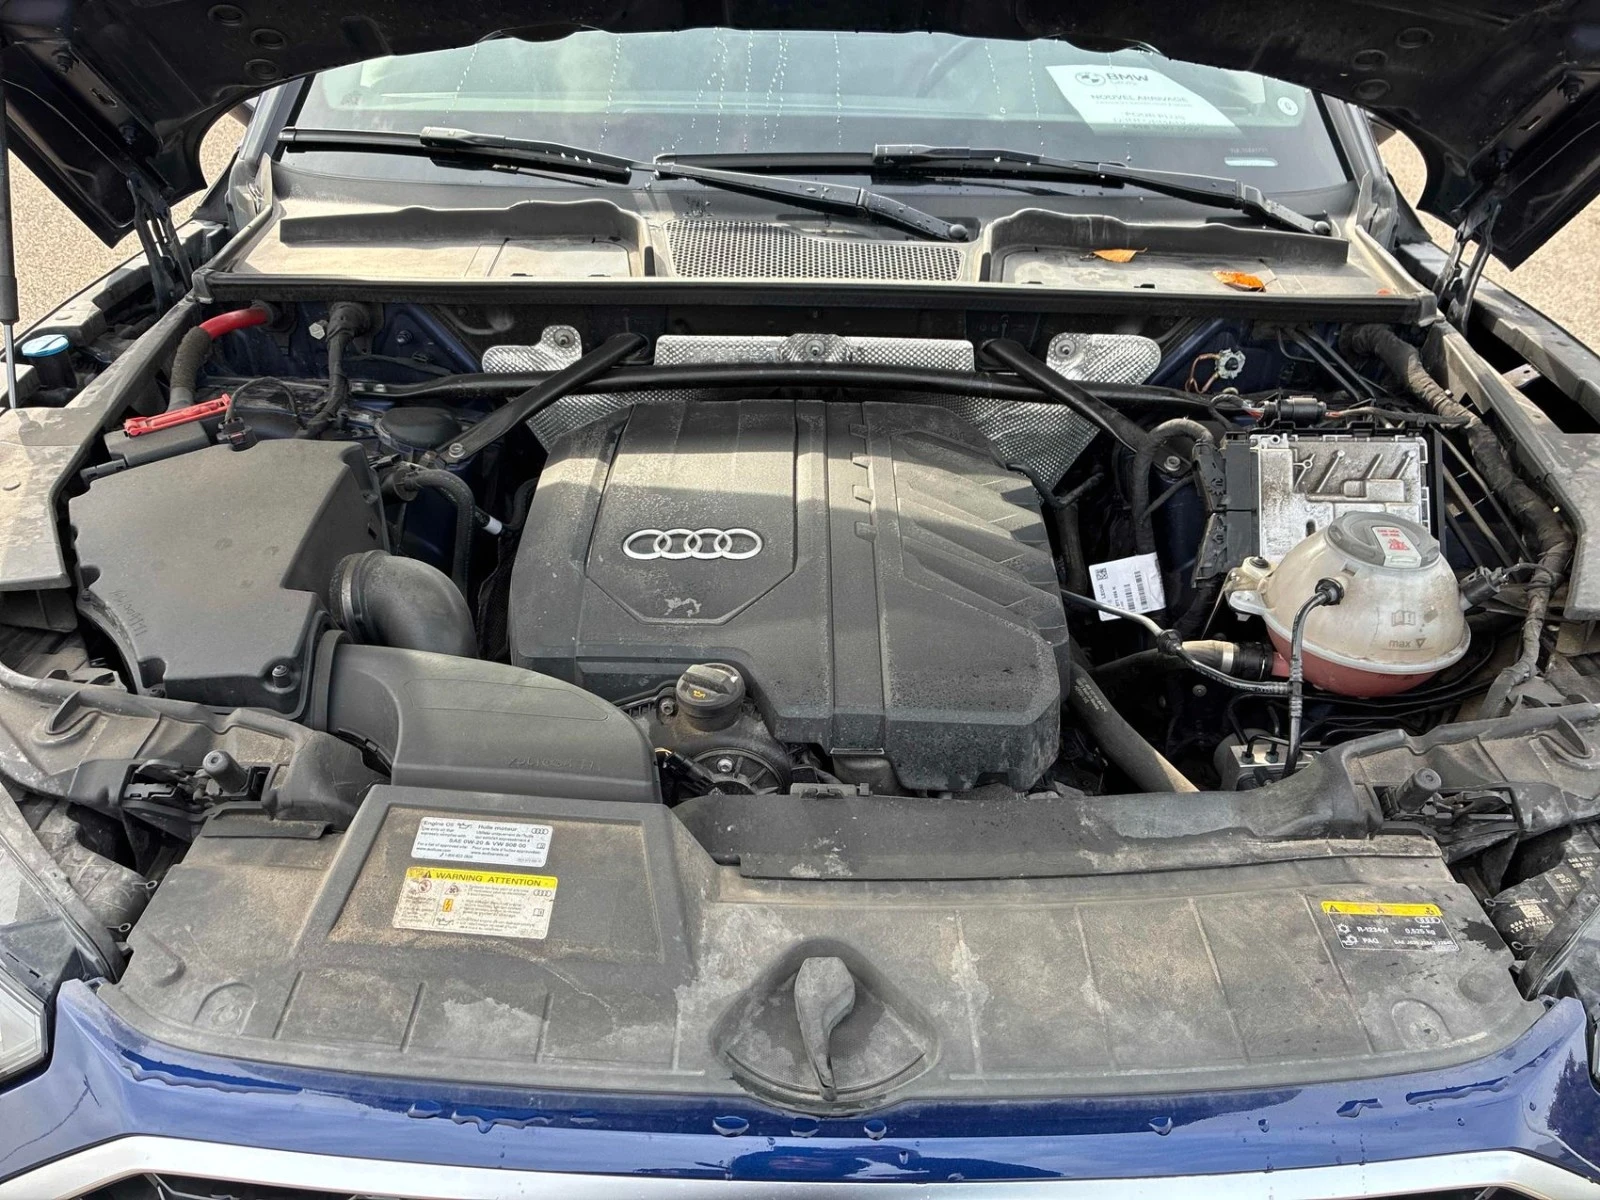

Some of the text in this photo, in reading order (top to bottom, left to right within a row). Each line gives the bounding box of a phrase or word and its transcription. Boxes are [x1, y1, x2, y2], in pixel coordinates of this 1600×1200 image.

[1106, 73, 1149, 82] BMW
[1388, 640, 1410, 648] max
[436, 872, 542, 886] WARNING ATTENTION
